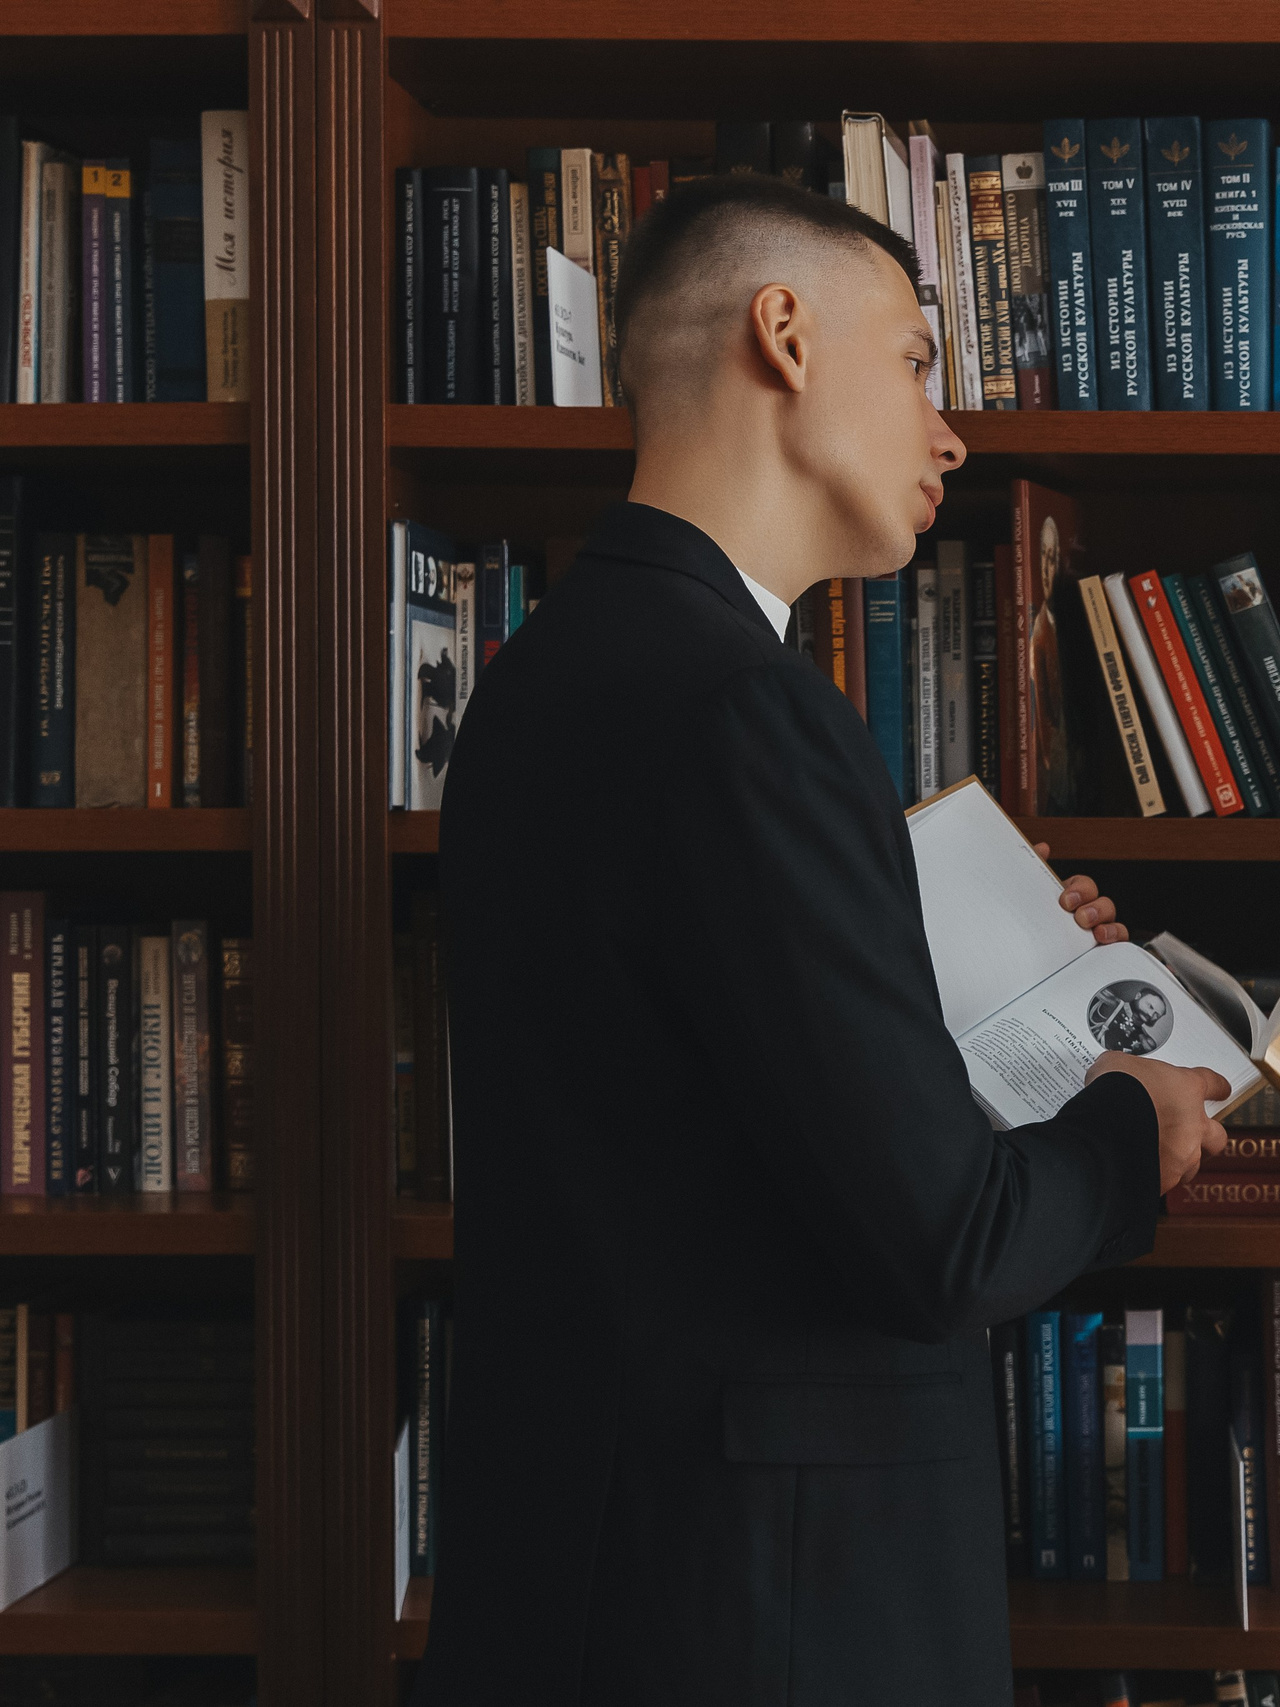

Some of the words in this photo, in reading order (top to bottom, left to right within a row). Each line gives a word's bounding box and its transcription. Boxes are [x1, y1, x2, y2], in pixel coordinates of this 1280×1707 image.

[91, 170, 99, 184] 1
[112, 172, 122, 186] 2
[216, 127, 245, 220] история
[1048, 182, 1069, 192] ТОМ
[1070, 179, 1083, 191] III
[1102, 181, 1123, 190] ТОМ
[1125, 178, 1135, 189] V
[1156, 183, 1178, 192] ТОМ
[1180, 179, 1192, 191] IV
[1221, 175, 1241, 184] ТОМ
[1242, 173, 1250, 183] II
[1056, 200, 1077, 208] XVII
[1110, 198, 1127, 206] XIX
[1162, 199, 1188, 208] XVIII
[1214, 203, 1258, 213] КИЕВСКАЯ
[1215, 190, 1247, 199] КНИГА
[1251, 190, 1257, 198] 1
[514, 197, 523, 254] ПОРТРЕТАХ
[1005, 193, 1020, 254] ЗИМНЕГО
[1019, 217, 1033, 267] ДВОРЦА
[1209, 221, 1264, 231] МОСКОВСКАЯ
[1226, 231, 1247, 239] РУСЬ
[215, 233, 237, 286] Моя
[405, 235, 413, 255] СССР
[993, 249, 1007, 264] XX
[974, 245, 992, 320] ЦЕРЕМОНИАЛЫ
[1008, 256, 1022, 292] ЛЮДИ
[1072, 252, 1086, 327] КУЛЬТУРЫ
[1122, 249, 1136, 325] КУЛЬТУРЫ
[1178, 252, 1191, 327] КУЛЬТУРЫ
[516, 267, 527, 338] ДИПЛОМАТИЯ
[1058, 279, 1071, 348] ИСТОРИИ
[1107, 277, 1119, 346] ИСТОРИИ
[1163, 280, 1176, 348] ИСТОРИИ
[1237, 258, 1249, 334] КУЛЬТУРЫ
[1222, 287, 1233, 354] ИСТОРИИ
[980, 322, 994, 371] СВЕТСКИЕ
[999, 326, 1012, 365] РОССИИ
[1063, 354, 1072, 372] ИЗ
[1110, 350, 1120, 370] ИЗ
[1124, 329, 1138, 397] РУССКОЙ
[1167, 354, 1177, 373] ИЗ
[1076, 332, 1090, 399] РУССКОЙ
[1181, 332, 1194, 399] РУССКОЙ
[1224, 361, 1234, 380] ИЗ
[1238, 340, 1251, 407] РУССКОЙ
[459, 598, 468, 635] России
[1017, 638, 1026, 694] ЛОМОНОСОВ
[1103, 651, 1124, 692] ФРАНЦИИ
[1175, 589, 1192, 620] САМЫЕ
[1187, 621, 1216, 687] ЛЕГЕНДАРНЫЕ
[1212, 685, 1236, 739] ПРАВИТЕЛИ
[1231, 738, 1251, 775] РОССИИ
[921, 704, 932, 748] ГРОЗНЫЙ
[1018, 696, 1028, 751] ВАСИЛЬЕВИЧ
[1115, 693, 1134, 730] ГЕНЕРАЛ
[1127, 730, 1145, 765] РОССИИ,
[1257, 738, 1277, 775] РОССИИ
[155, 782, 162, 797] 1
[922, 753, 932, 788] ИОАНН
[1020, 754, 1028, 790] МИХАИЛ
[51, 934, 64, 1008] ПУСТЫНЬ
[12, 971, 31, 1057] ГУБЕРНИЯ
[144, 1087, 161, 1104] И
[12, 1063, 31, 1186] ТАВРИЧЕСКАЯ
